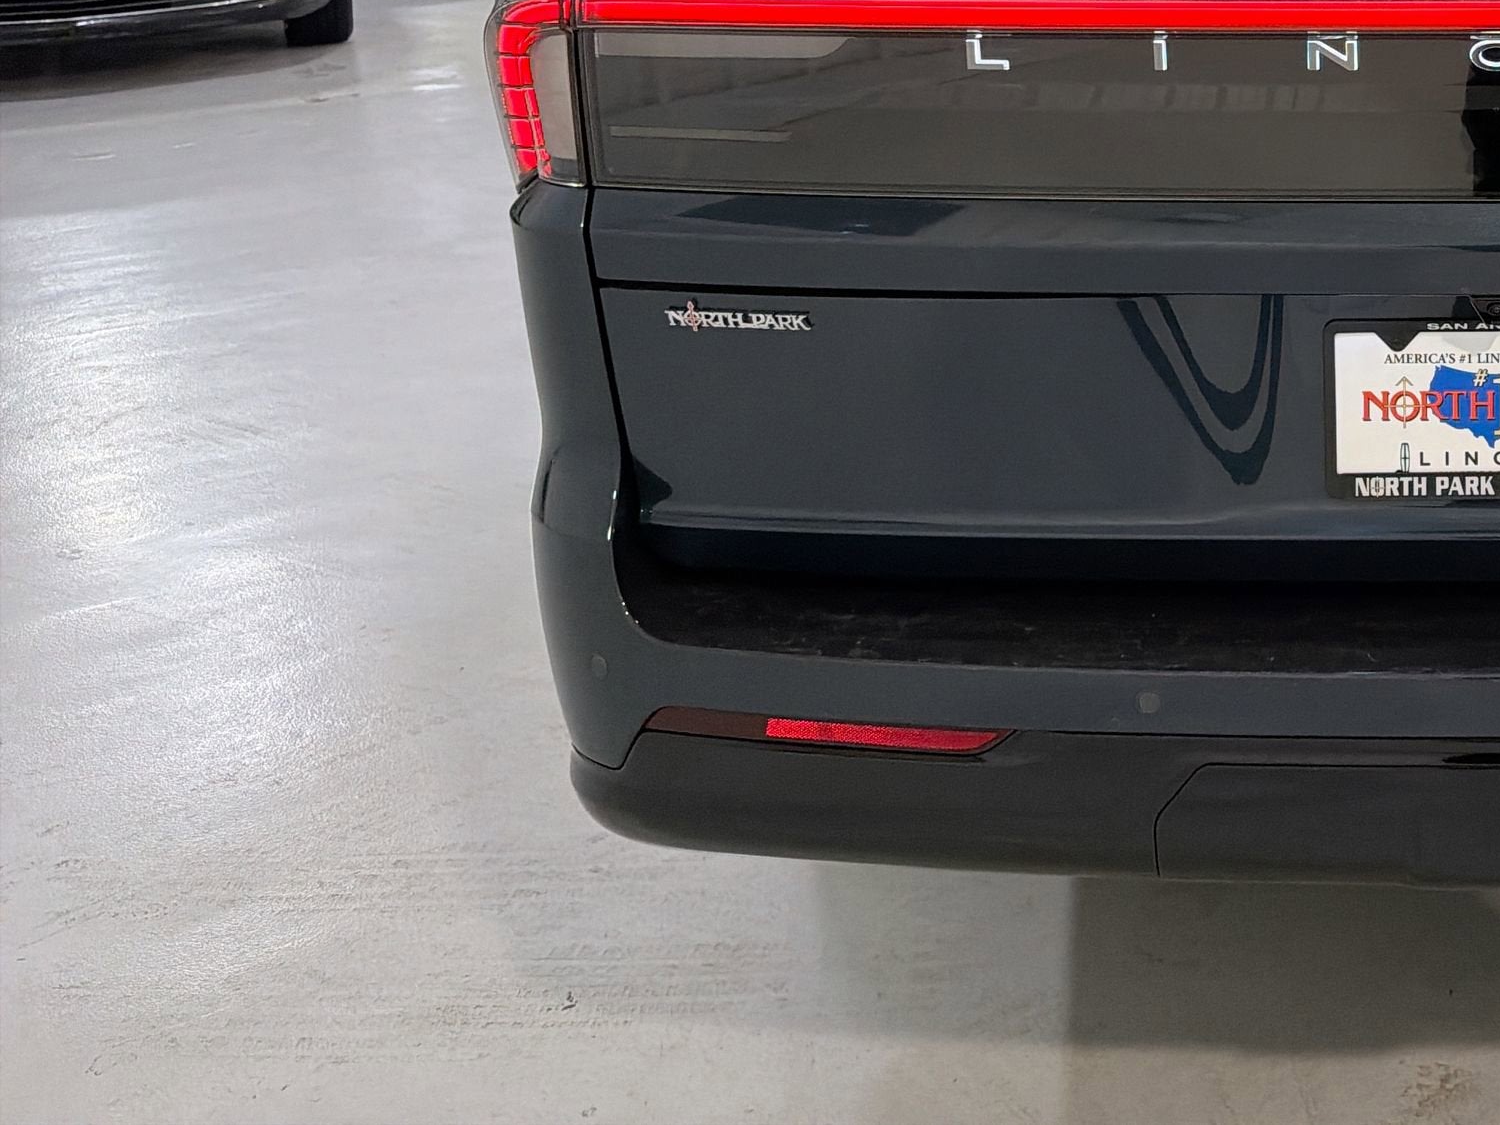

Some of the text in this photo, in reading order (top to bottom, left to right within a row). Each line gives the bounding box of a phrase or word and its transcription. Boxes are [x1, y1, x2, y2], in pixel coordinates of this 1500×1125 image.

[664, 309, 811, 331] NORTH PARK
[1426, 322, 1468, 330] SAN
[1384, 352, 1456, 365] AMERICA'S
[1458, 352, 1473, 364] #1
[1362, 389, 1496, 422] NORTH
[1355, 476, 1427, 497] NORTH
[1435, 475, 1496, 496] PARK
